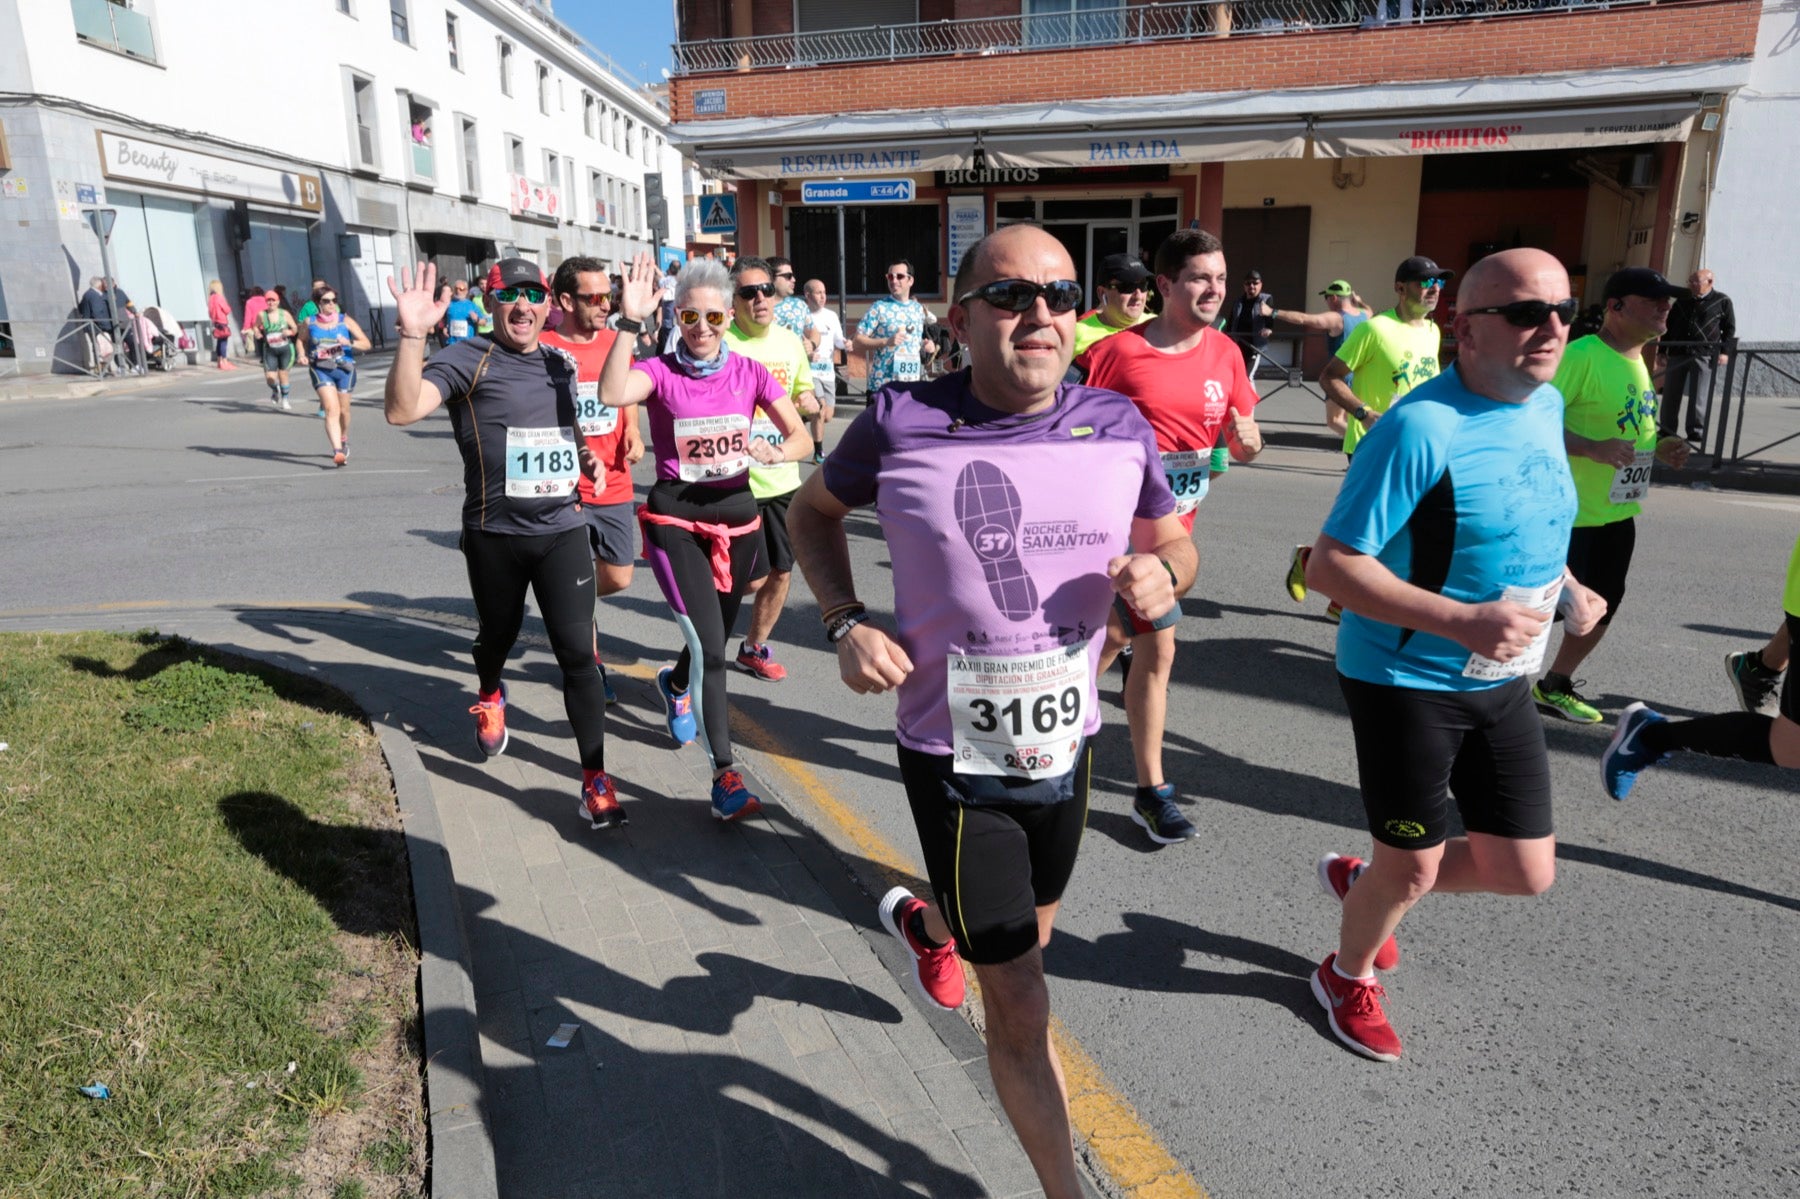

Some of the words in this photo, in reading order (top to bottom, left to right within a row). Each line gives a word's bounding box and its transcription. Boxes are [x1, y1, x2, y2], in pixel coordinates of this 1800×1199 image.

[1088, 139, 1182, 161] PARADA
[117, 140, 179, 182] Beauty
[779, 149, 922, 173] RESTAURANTE
[945, 167, 1040, 184] BICHITOS
[305, 180, 316, 204] B
[805, 187, 848, 198] Granada
[900, 361, 918, 374] 833
[686, 433, 744, 459] 2305
[517, 449, 575, 474] 1183
[1022, 534, 1054, 550] SAN
[1055, 529, 1109, 547] ANTÓN
[1023, 524, 1062, 536] NOCHE
[1063, 523, 1079, 534] DE
[979, 532, 1009, 552] 37
[983, 661, 1009, 674] GRAN
[1011, 658, 1044, 673] PREMIO
[1046, 656, 1056, 668] DE
[1024, 673, 1034, 682] DE
[1036, 665, 1069, 681] GRANADA
[968, 686, 1081, 736] 3169
